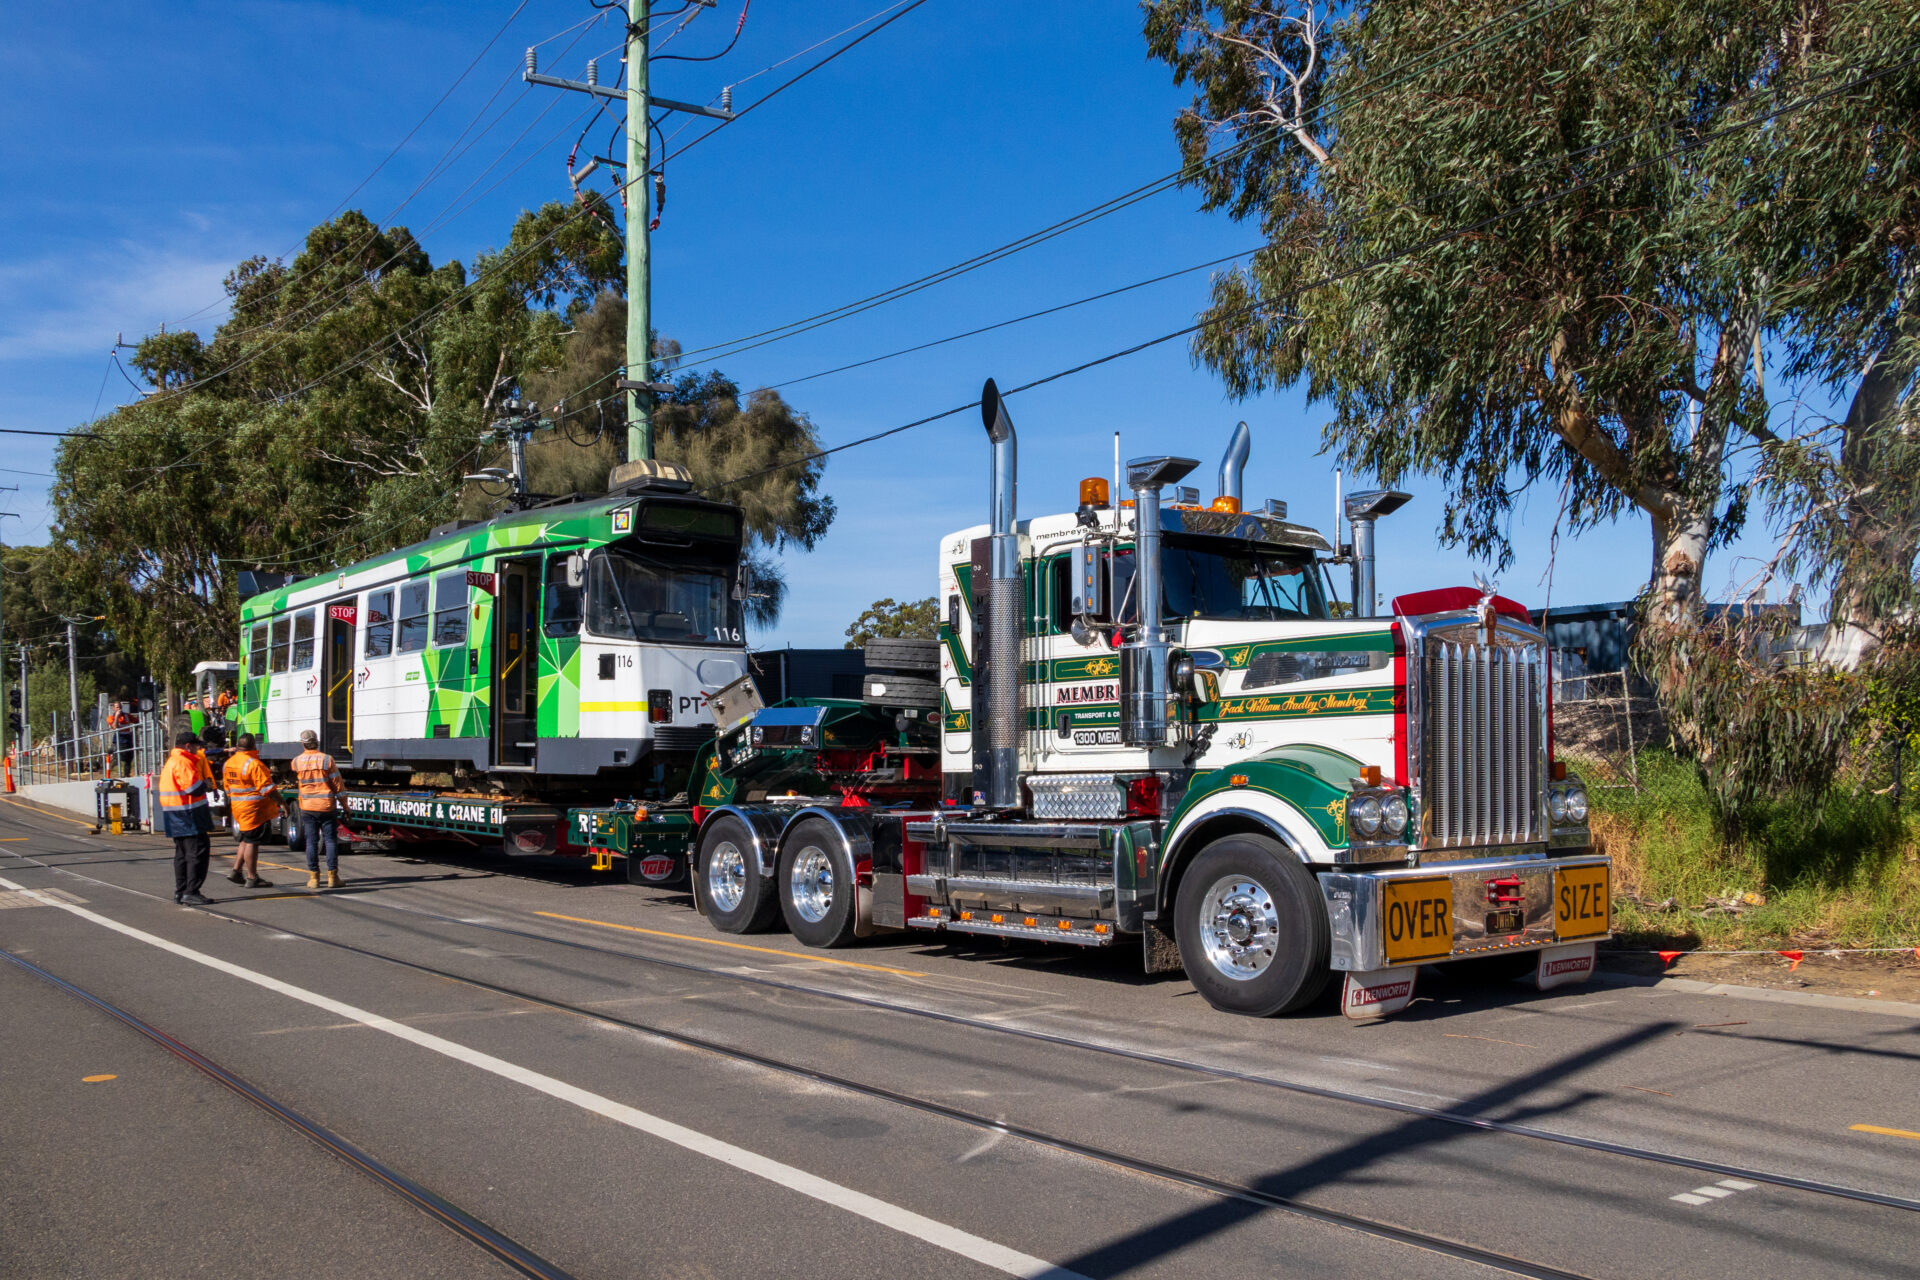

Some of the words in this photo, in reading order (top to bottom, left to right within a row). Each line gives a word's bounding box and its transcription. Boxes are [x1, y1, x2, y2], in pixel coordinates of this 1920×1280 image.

[467, 573, 492, 585] STOP
[331, 607, 355, 618] STOP
[714, 627, 740, 641] 116
[617, 655, 633, 668] 116
[306, 680, 314, 695] PT
[358, 672, 366, 688] PT
[1246, 697, 1281, 712] William
[1074, 711, 1106, 720] TRANSPORT
[1074, 731, 1096, 745] 1300
[379, 799, 432, 818] TRANSPORT
[436, 804, 444, 819] &
[449, 805, 485, 823] CRANE
[640, 859, 675, 875] TUFF
[1560, 883, 1603, 921] SIZE
[1389, 898, 1447, 941] OVER
[1552, 959, 1590, 972] KENWORTH
[1365, 983, 1409, 1001] KENWORTH
